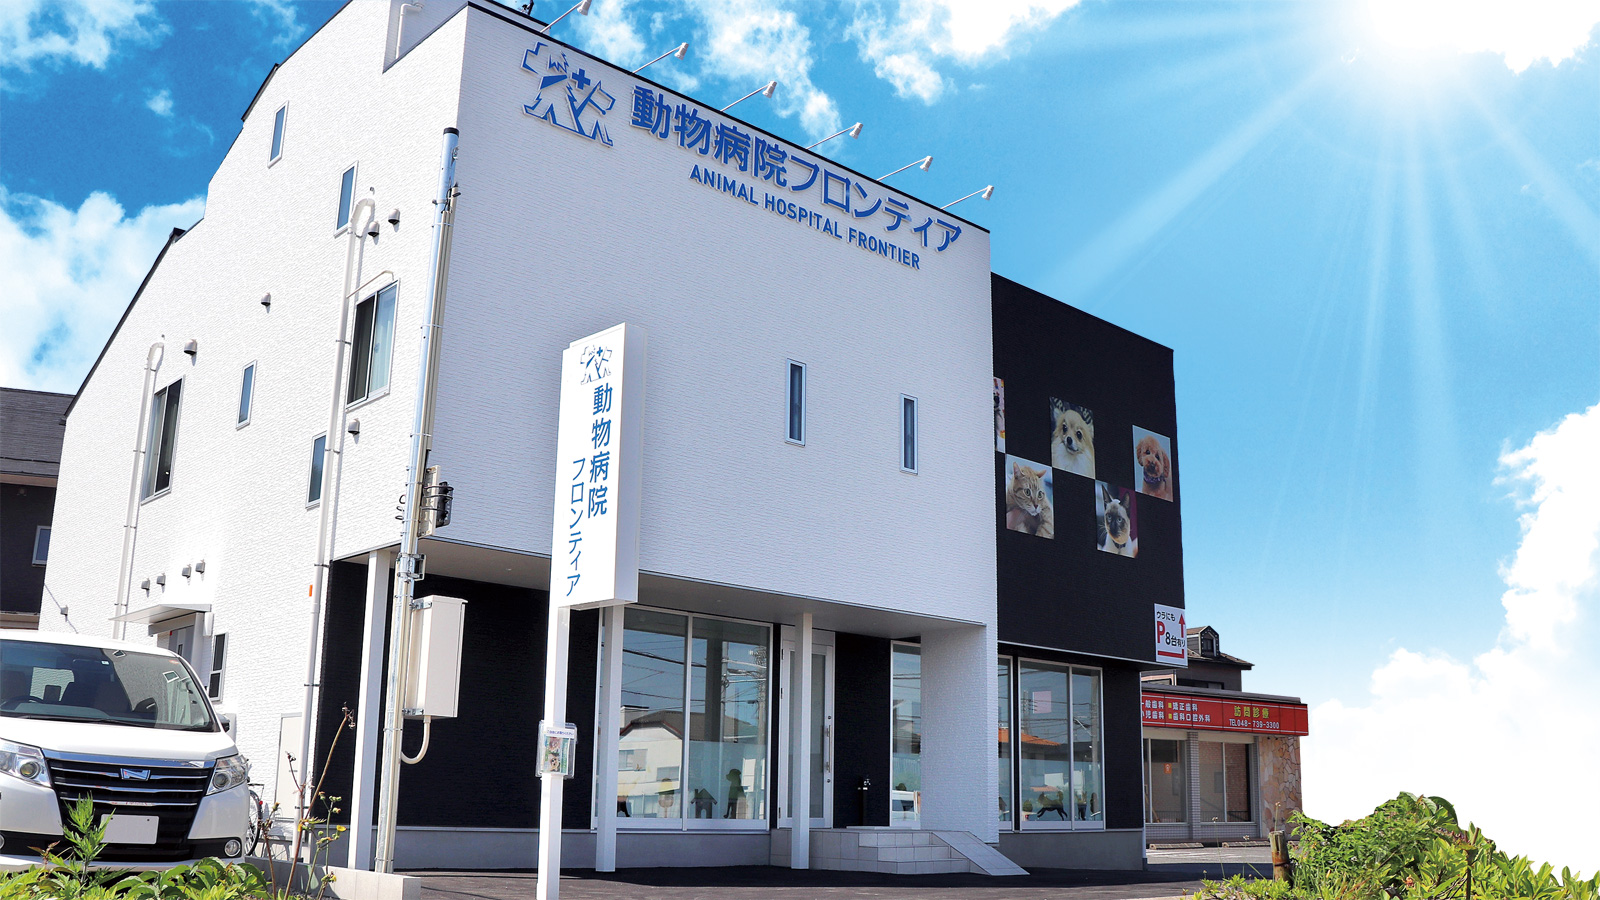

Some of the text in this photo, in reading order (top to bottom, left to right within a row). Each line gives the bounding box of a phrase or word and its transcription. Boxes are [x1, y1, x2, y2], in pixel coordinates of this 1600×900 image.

[630, 85, 962, 252] 動物病院フロンティア
[689, 164, 921, 270] ANIMAL HOSPITAL FRONTIER
[588, 382, 613, 518] 動物病院
[566, 457, 586, 597] フロンティア
[1156, 611, 1175, 621] ウラにも
[1172, 701, 1198, 712] 矯正歯科
[1172, 712, 1211, 723] 歯科口腔外科
[1234, 705, 1269, 718] 訪問診療
